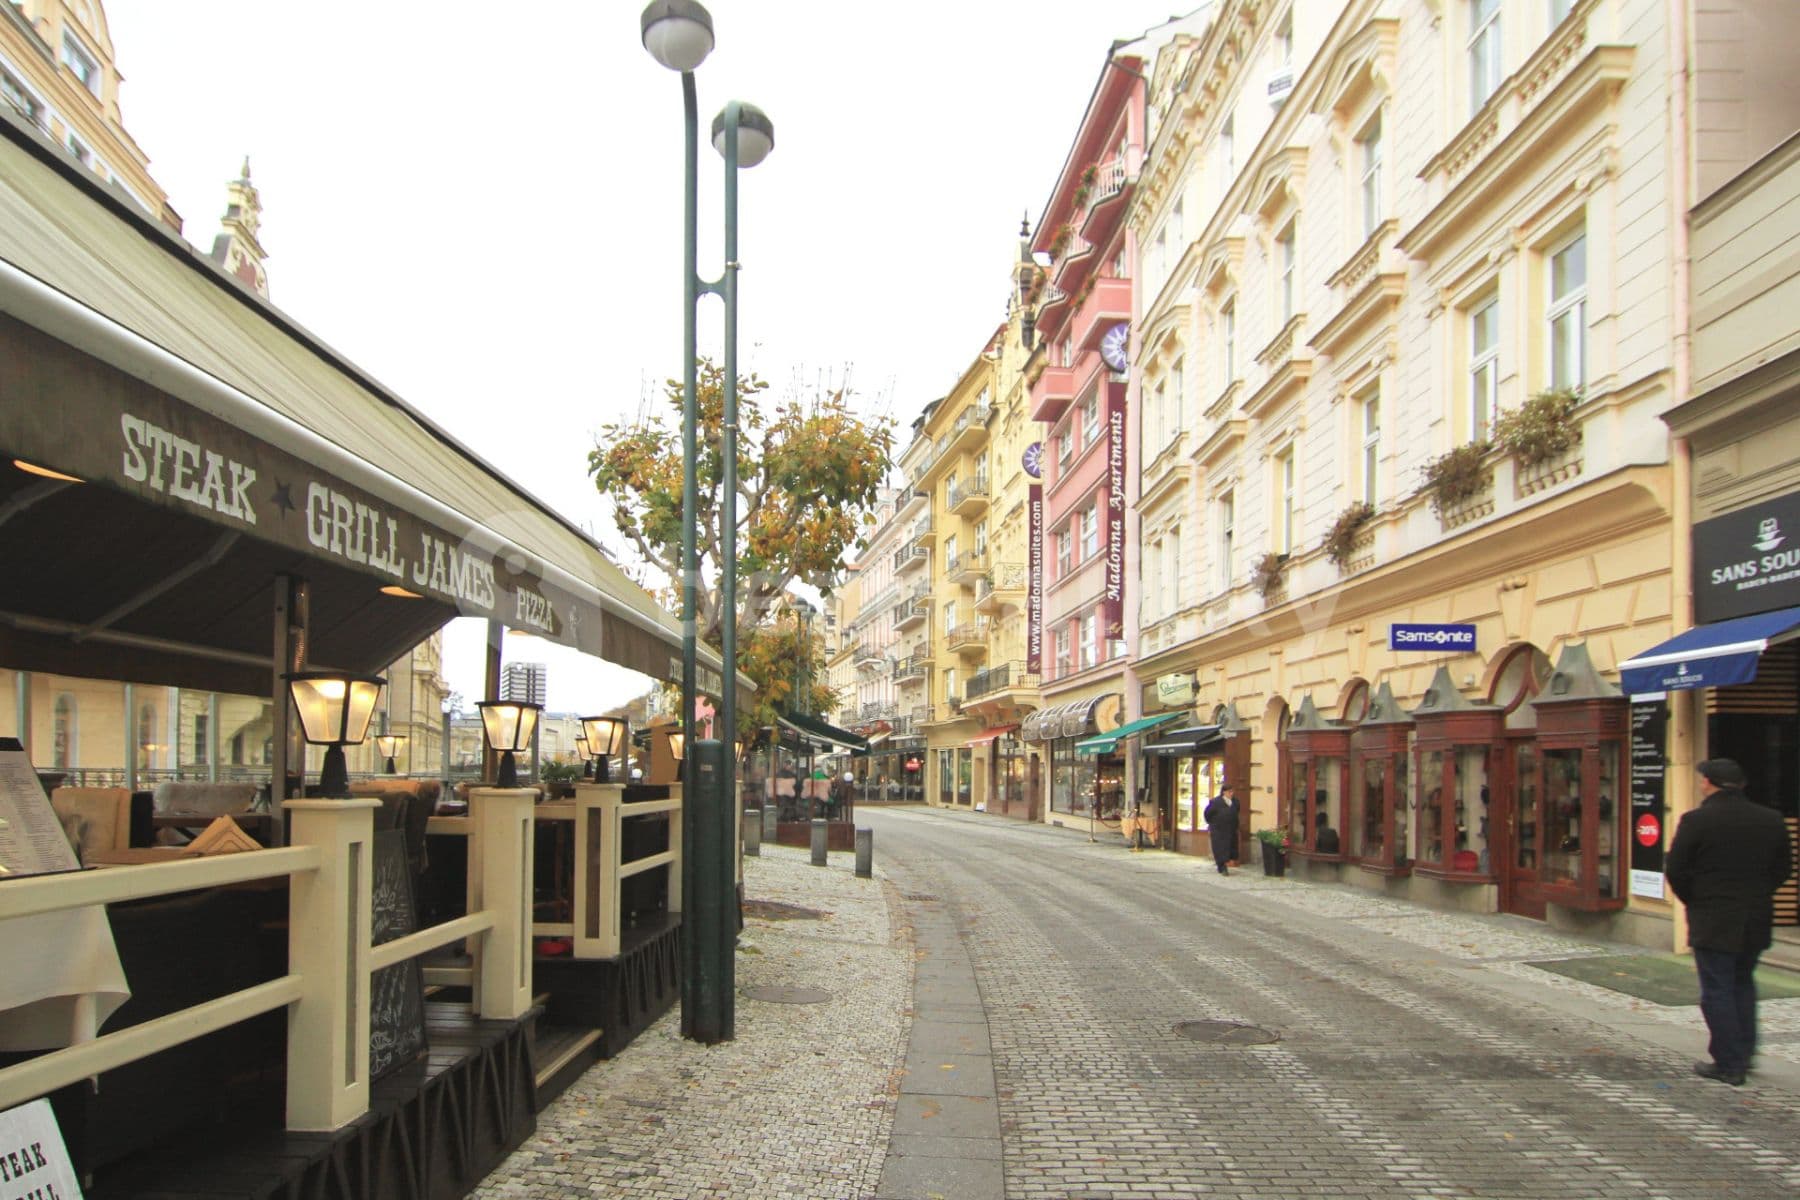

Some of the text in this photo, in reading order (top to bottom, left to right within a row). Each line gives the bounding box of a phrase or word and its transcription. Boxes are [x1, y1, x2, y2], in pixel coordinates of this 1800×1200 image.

[121, 413, 553, 632] STEAK GRILL JAMES PIZZA
[1031, 499, 1042, 656] www.madonnasuites.com
[1106, 410, 1126, 601] Madonna Apartments
[1711, 560, 1758, 585] SANS
[1396, 630, 1473, 644] Samsonite
